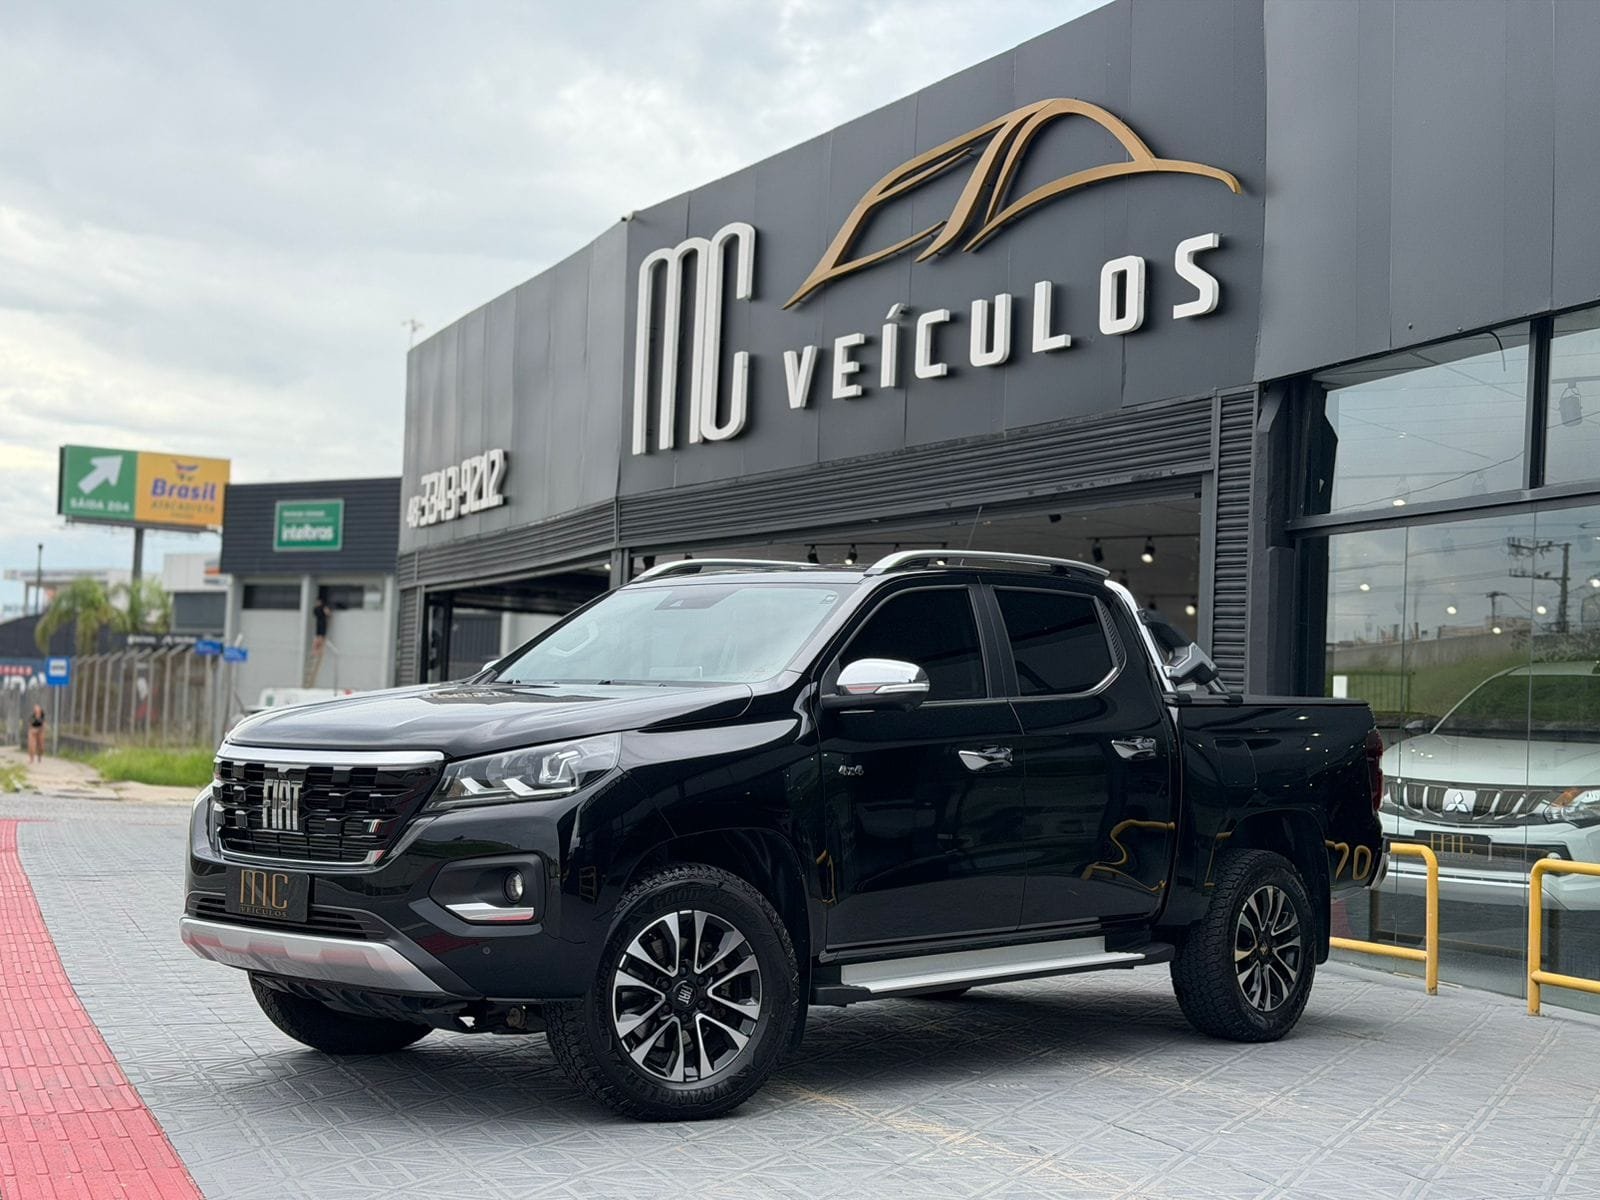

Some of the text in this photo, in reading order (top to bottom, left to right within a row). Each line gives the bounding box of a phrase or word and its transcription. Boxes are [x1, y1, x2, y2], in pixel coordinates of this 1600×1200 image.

[631, 221, 757, 456] MC
[783, 231, 1221, 410] VEÍCULOS
[151, 477, 217, 502] Brasil
[262, 778, 304, 831] FIAT
[239, 868, 289, 909] MC
[676, 983, 694, 1005] FIAT
